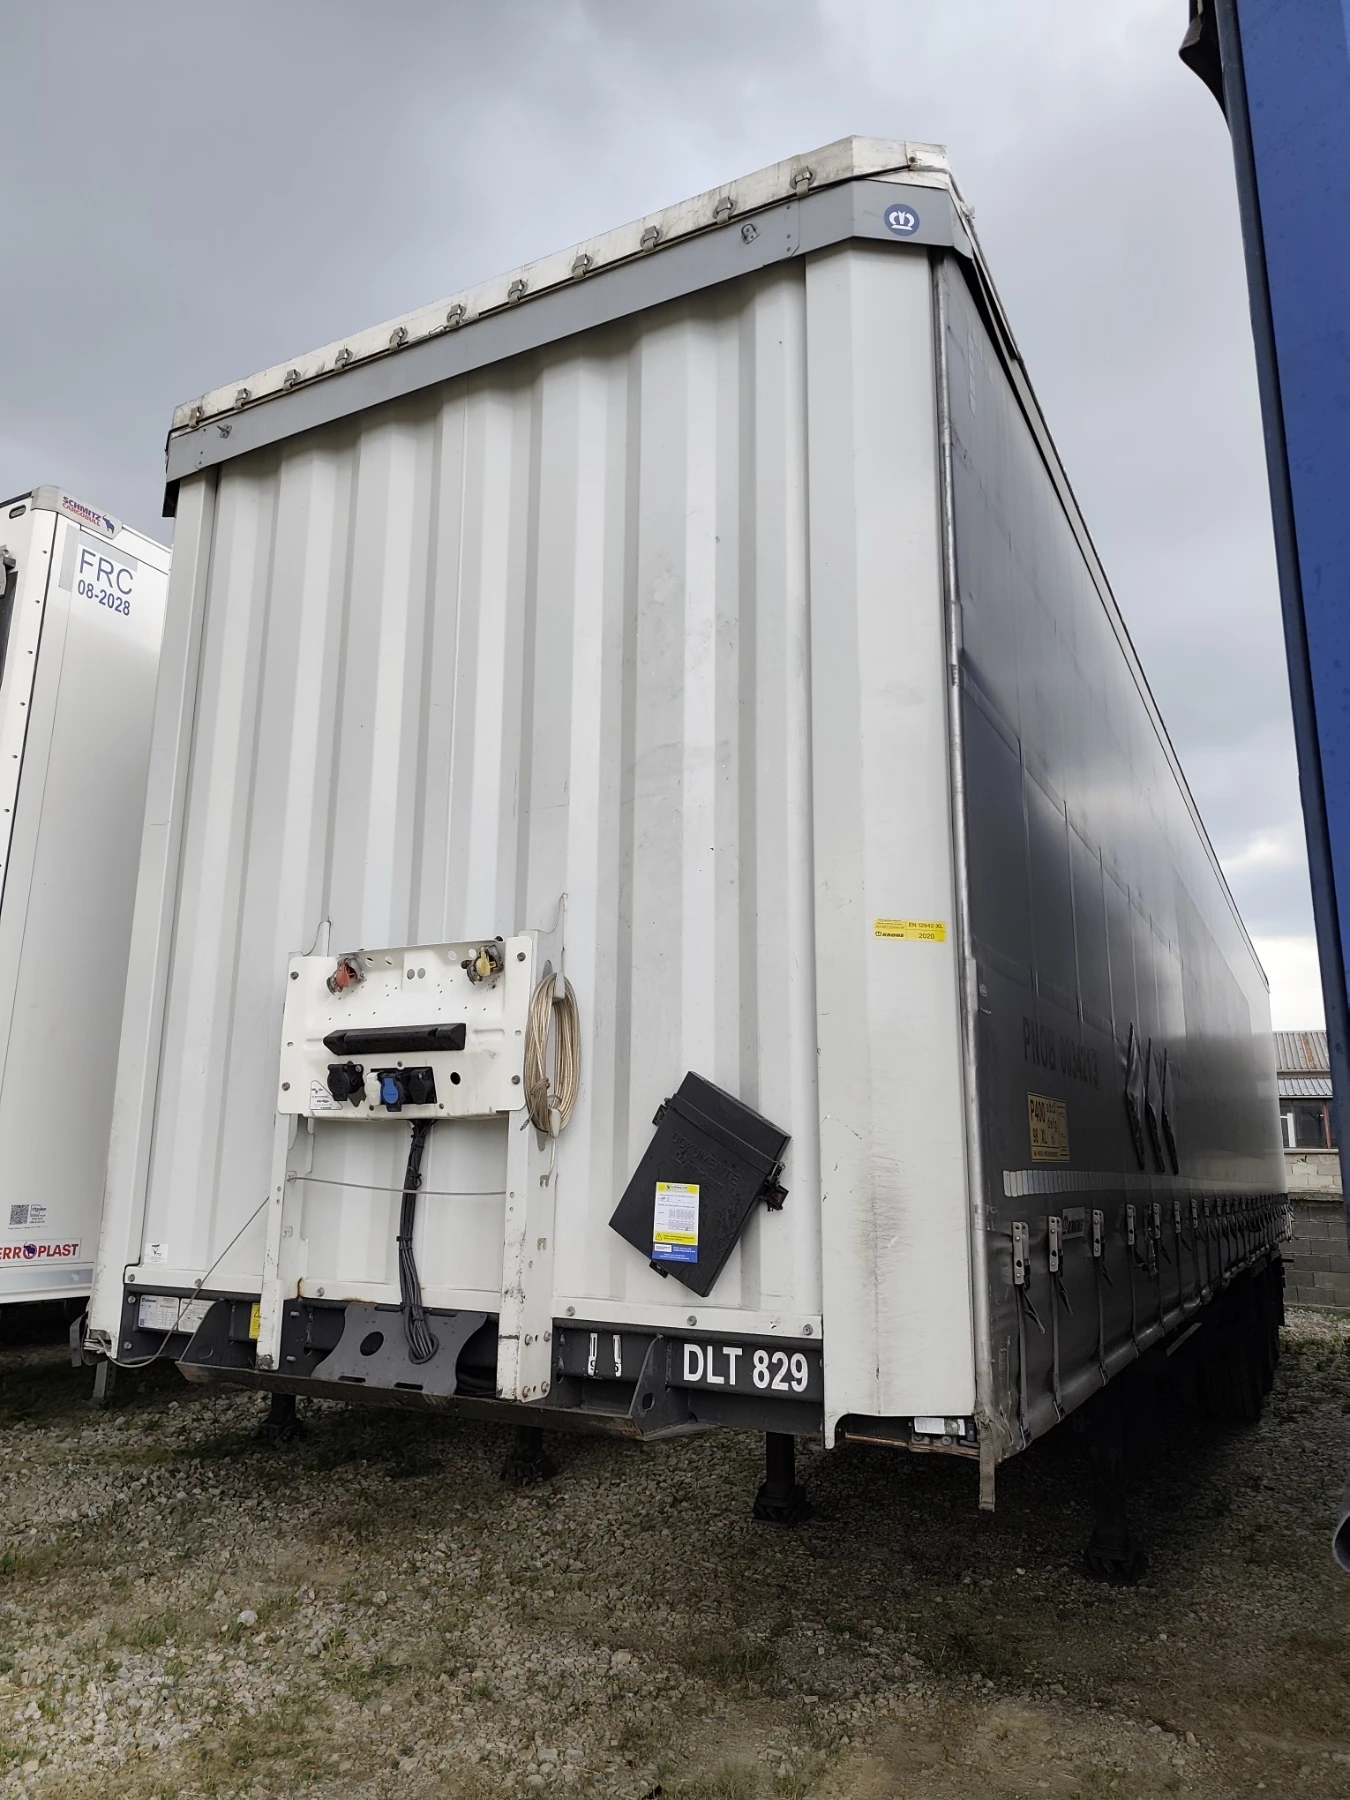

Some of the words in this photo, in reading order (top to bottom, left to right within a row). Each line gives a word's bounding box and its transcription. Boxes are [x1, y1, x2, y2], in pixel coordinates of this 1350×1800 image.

[62, 502, 100, 527] CARGOBULL
[63, 496, 102, 520] SCHMITZ
[79, 548, 133, 595] FRC
[77, 579, 131, 616] 08-2028
[918, 932, 935, 940] 2020
[1022, 1015, 1056, 1070] PNOB
[683, 1343, 743, 1386] DLT
[752, 1349, 809, 1393] 829
